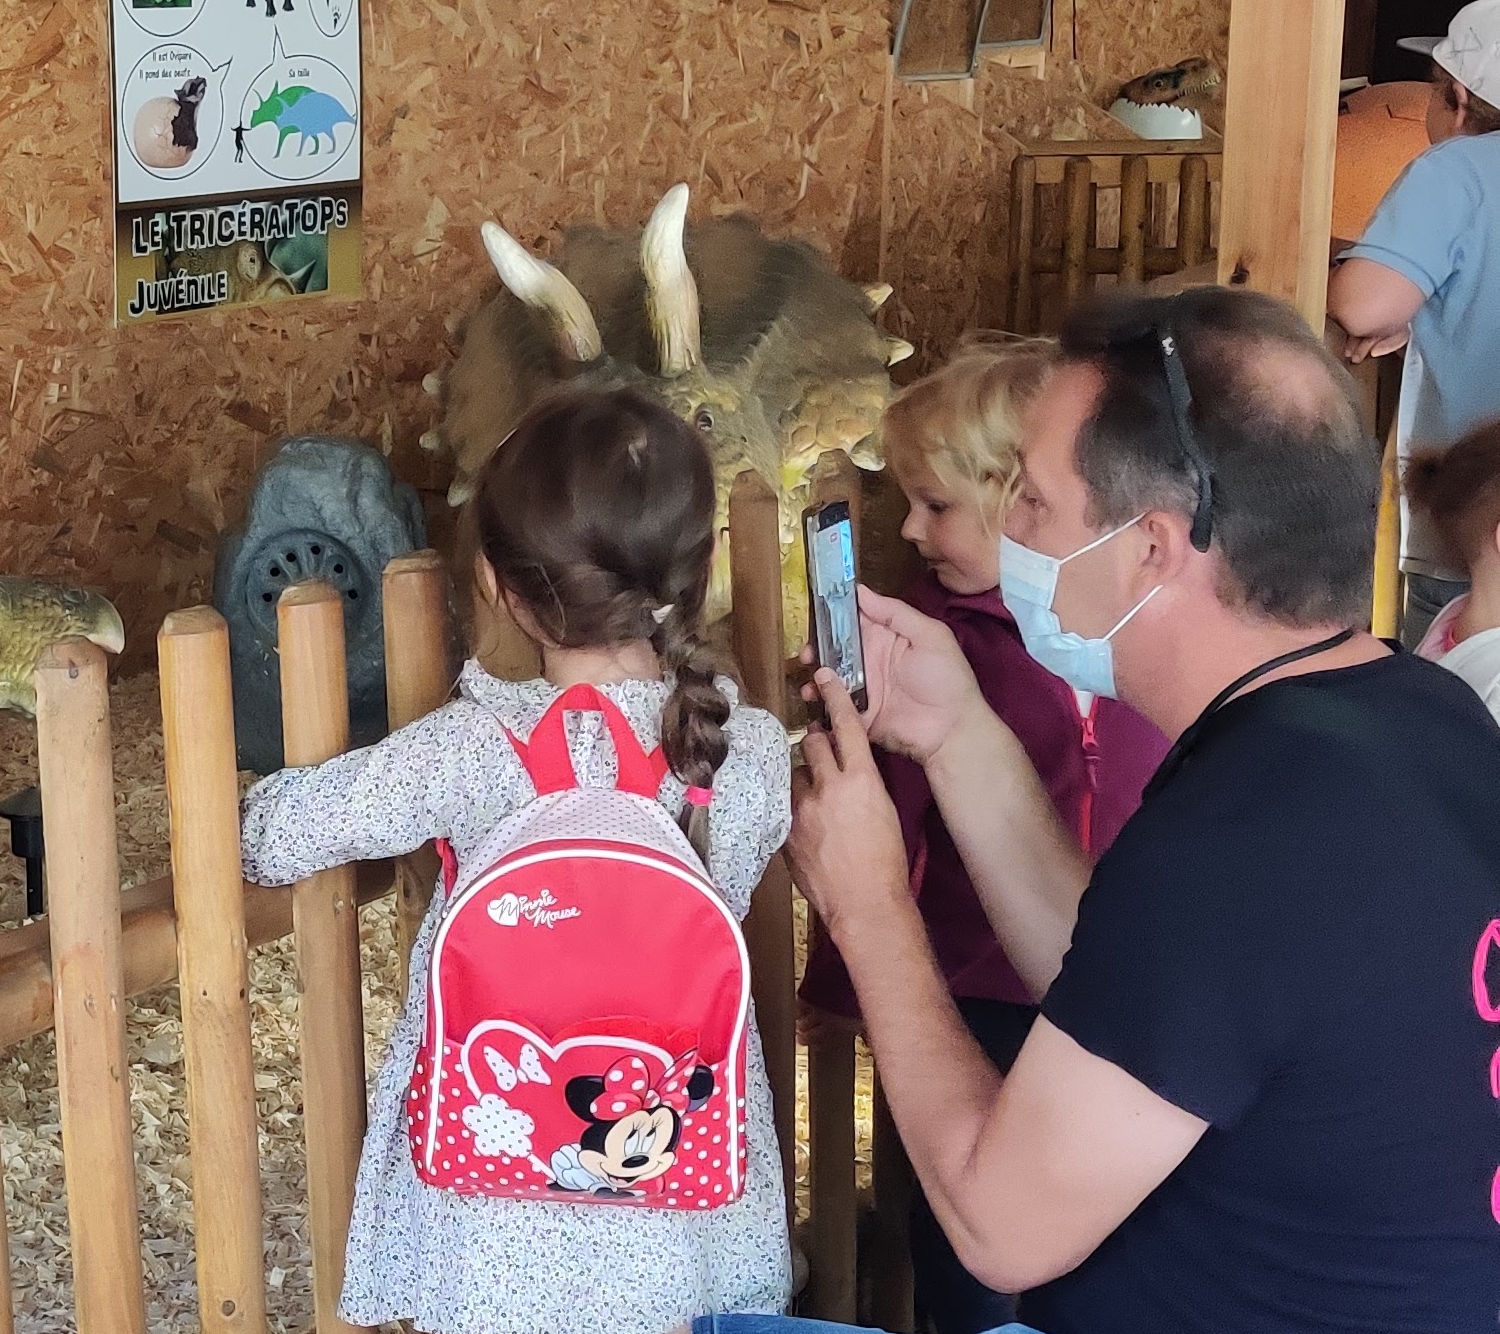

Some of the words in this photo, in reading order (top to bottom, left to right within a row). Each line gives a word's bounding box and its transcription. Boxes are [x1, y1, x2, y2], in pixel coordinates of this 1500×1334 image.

[132, 216, 163, 257] LE
[170, 196, 348, 252] TRICÉRATOPS
[488, 888, 559, 923] Minnie
[524, 906, 583, 930] Mouse
